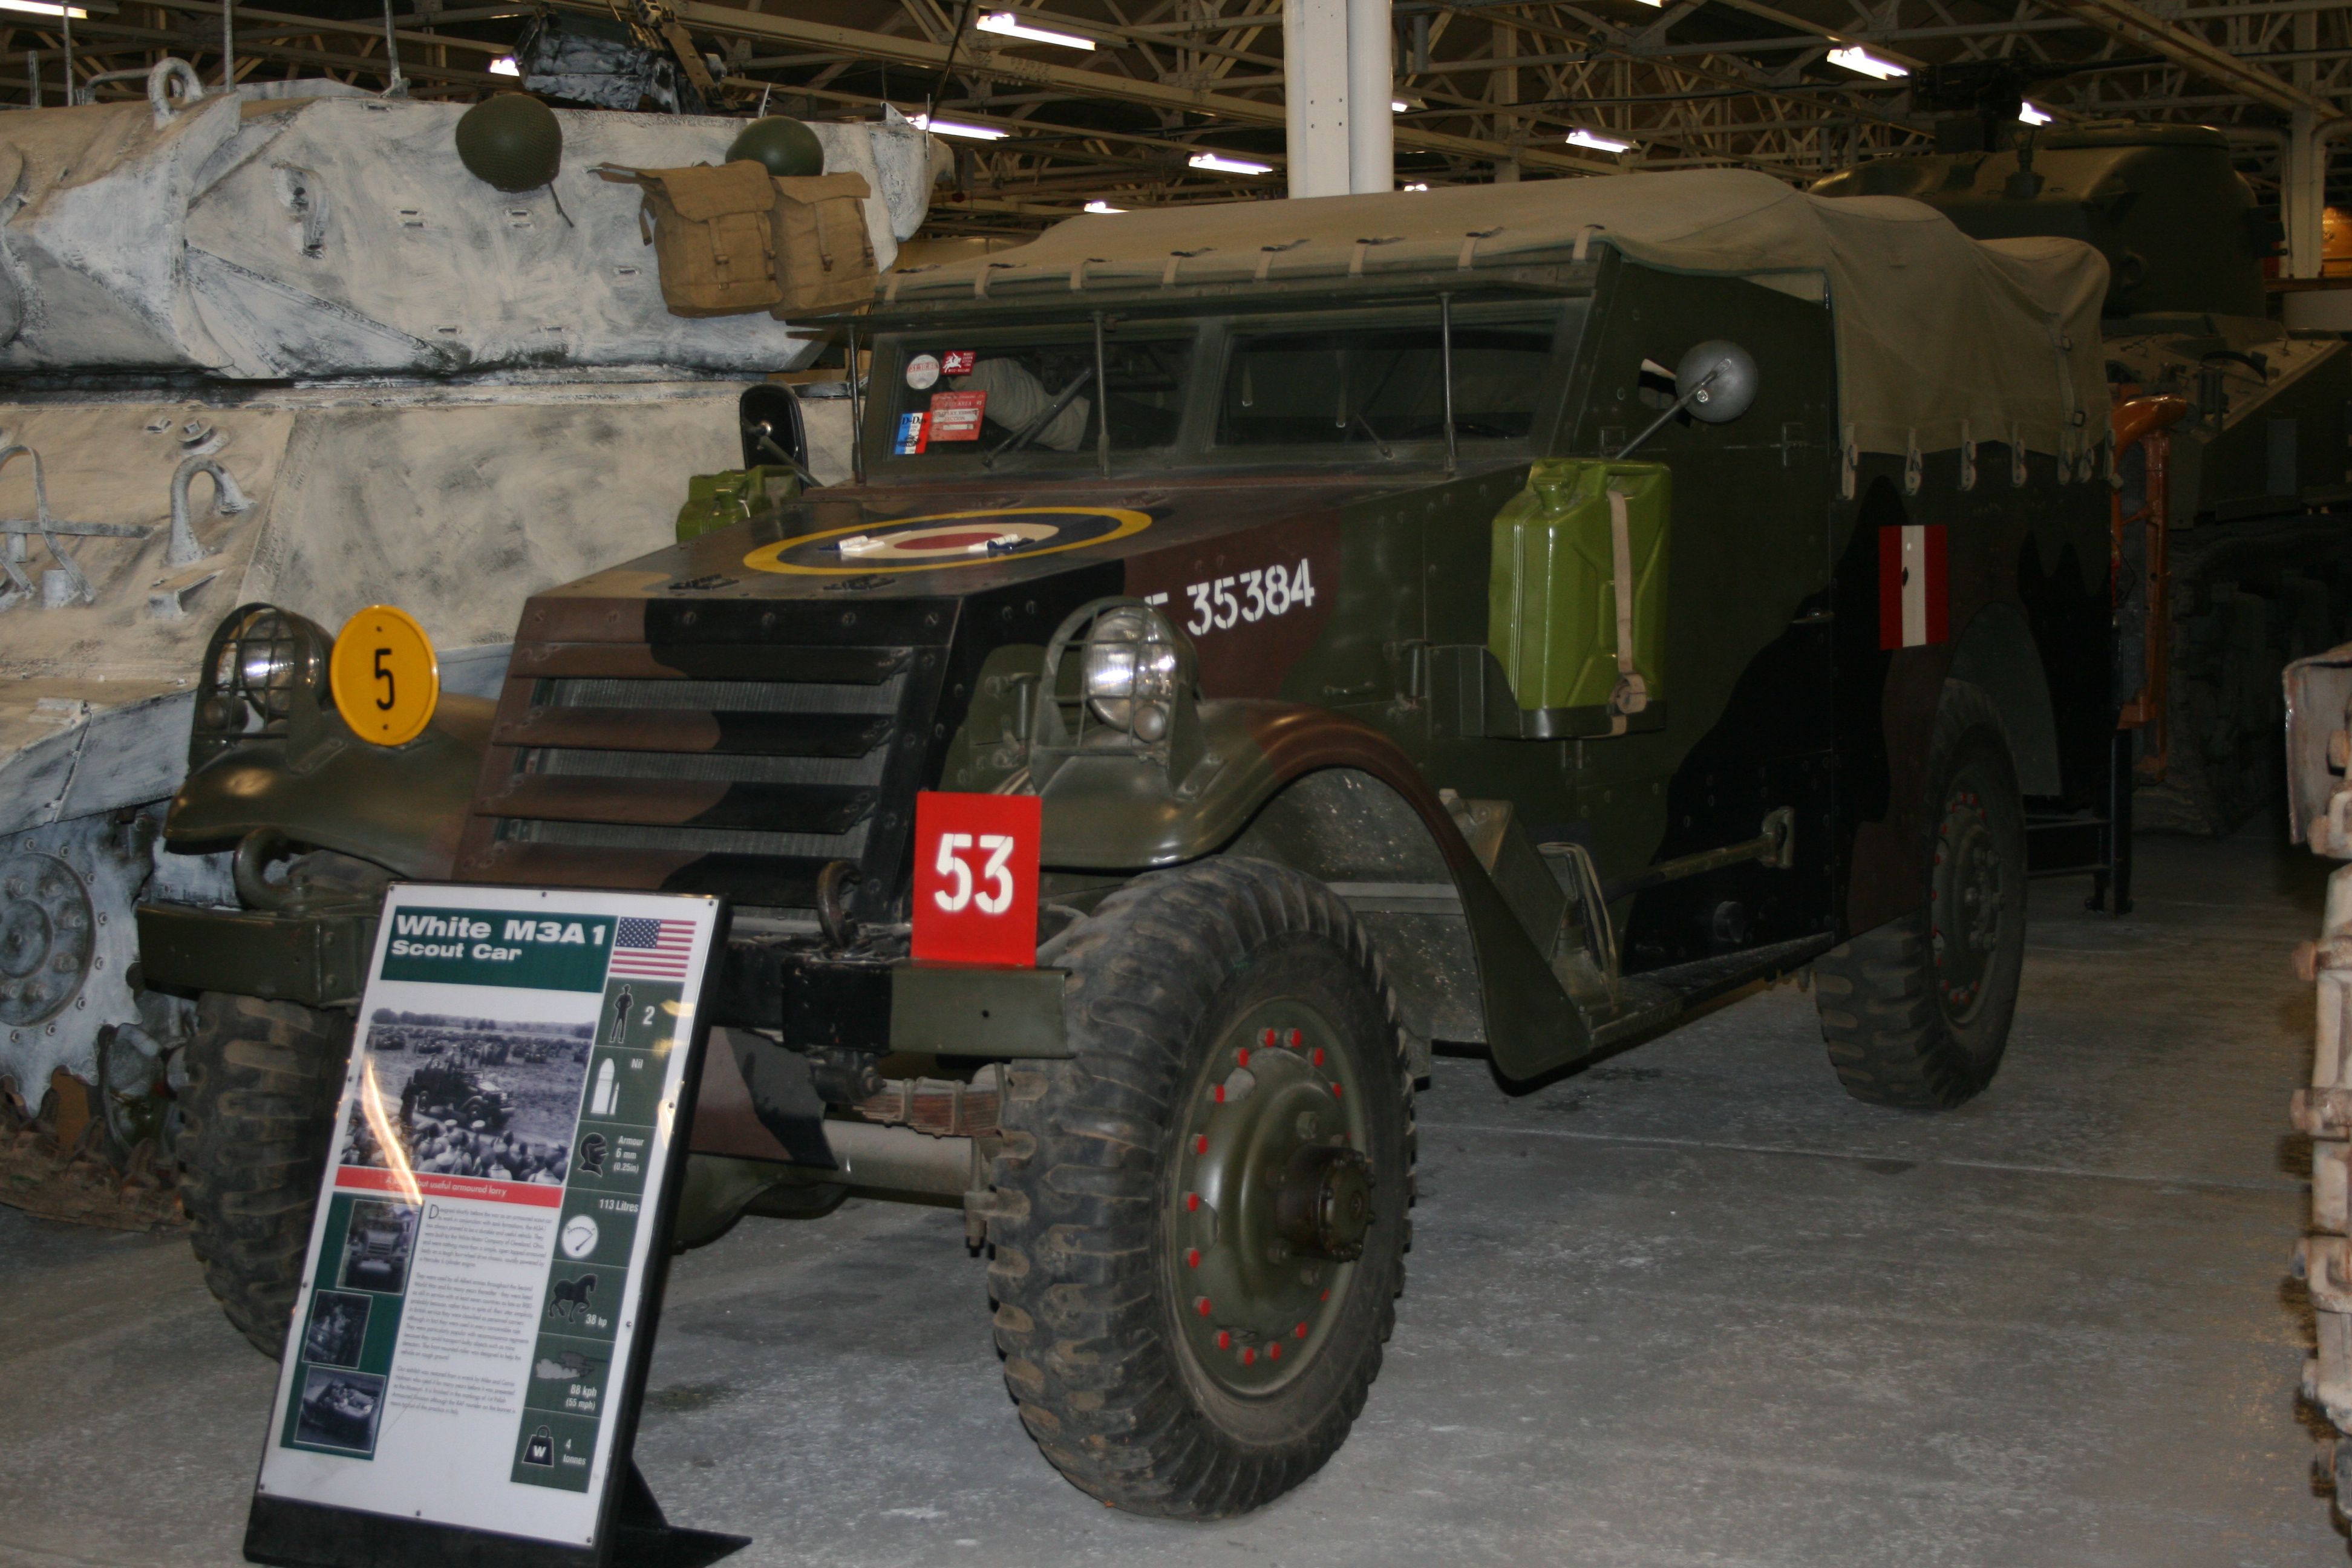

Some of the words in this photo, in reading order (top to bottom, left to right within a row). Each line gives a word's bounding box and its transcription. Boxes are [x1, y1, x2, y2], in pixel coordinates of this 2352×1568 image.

[1186, 558, 1315, 636] 35384
[374, 648, 395, 710] 5
[935, 833, 1014, 913] 53
[396, 915, 492, 938] White
[391, 939, 465, 958] Scout
[472, 943, 523, 961] Car
[643, 1005, 655, 1025] 2
[631, 1058, 644, 1069] Nil
[618, 1135, 645, 1146] Armour
[616, 1148, 622, 1158] 6
[417, 1179, 428, 1187] but
[430, 1180, 451, 1190] useful
[452, 1184, 488, 1194] armoured
[489, 1185, 507, 1197] lorry
[599, 1198, 614, 1210] 113
[616, 1200, 639, 1212] Litres
[570, 1384, 581, 1395] 88
[583, 1385, 597, 1399] kph
[566, 1398, 577, 1408] (55
[578, 1400, 596, 1411] mph)
[566, 1439, 572, 1449] 4
[563, 1454, 586, 1465] tonnes
